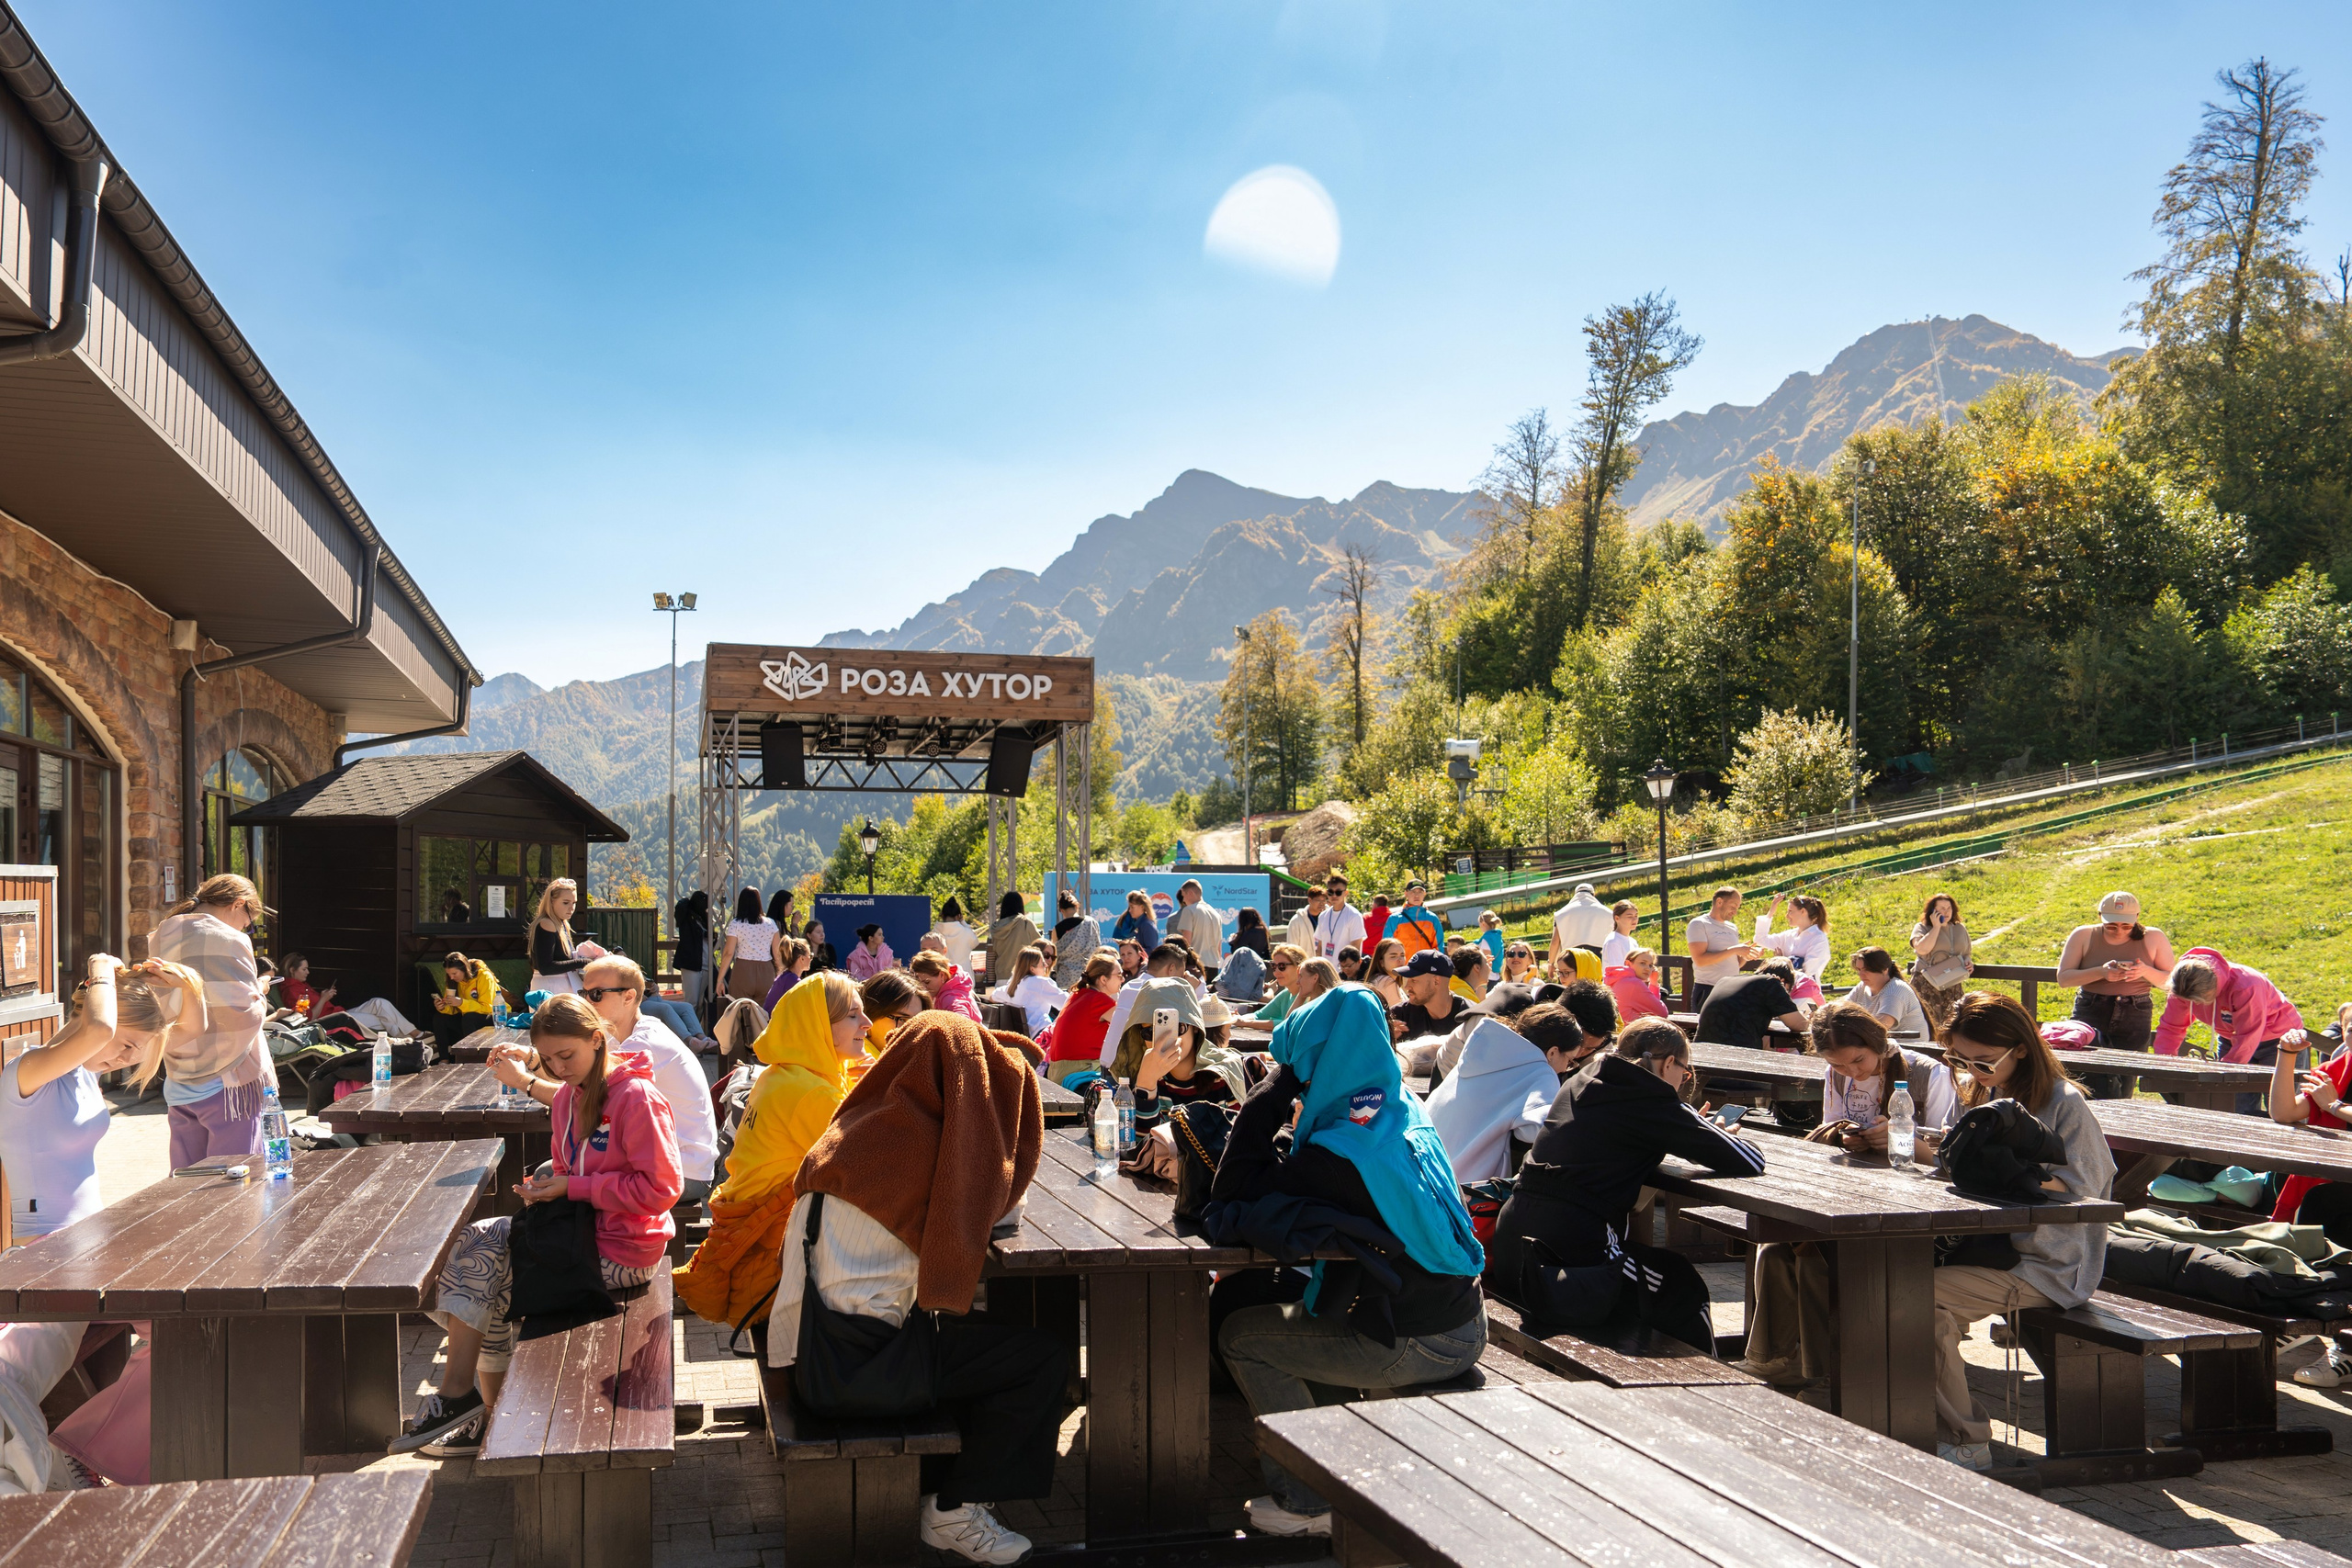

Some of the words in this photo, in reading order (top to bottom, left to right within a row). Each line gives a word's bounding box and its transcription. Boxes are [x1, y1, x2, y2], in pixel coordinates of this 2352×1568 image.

[841, 668, 932, 697] РОЗА
[941, 671, 1053, 701] ХУТОР
[1224, 886, 1258, 895] NordStar
[820, 897, 875, 908] Гастрофест
[1353, 1093, 1383, 1103] MOUTAI
